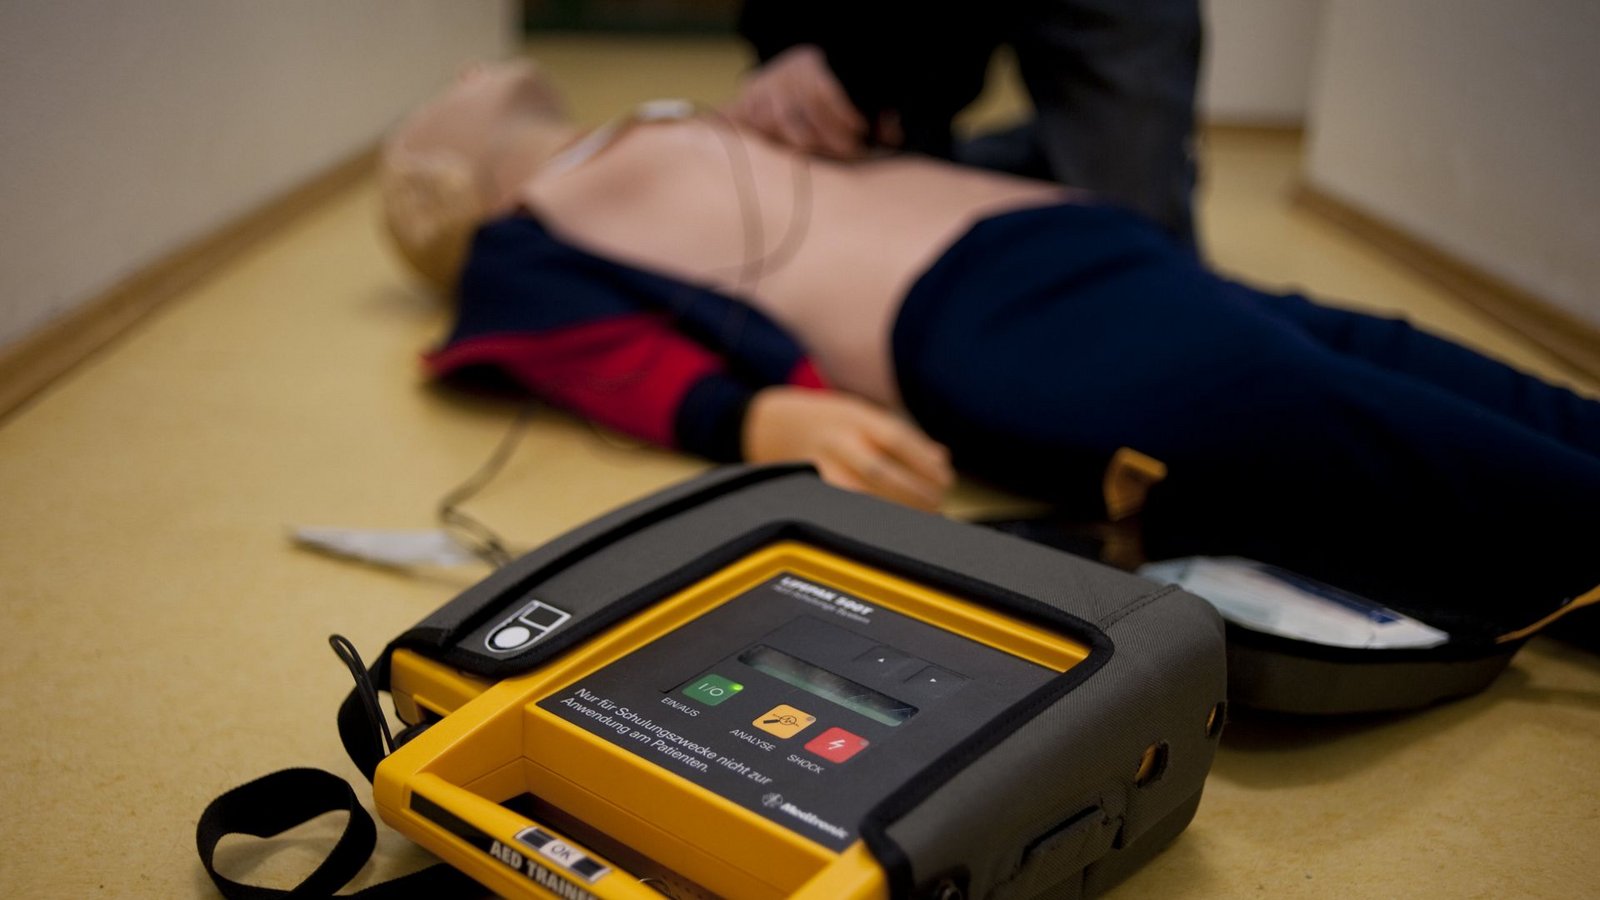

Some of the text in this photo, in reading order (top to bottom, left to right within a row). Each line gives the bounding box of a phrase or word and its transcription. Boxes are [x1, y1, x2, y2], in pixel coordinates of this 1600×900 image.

[661, 697, 700, 718] EIN/AUS
[560, 697, 709, 773] Anwendung am Patienten.
[575, 688, 773, 785] Nur für Schulungszwecke nicht zur
[729, 729, 776, 752] ANALYSE
[786, 754, 826, 774] SHOCK
[780, 803, 848, 839] Medtronic
[489, 840, 523, 870] AED
[551, 844, 570, 860] OK
